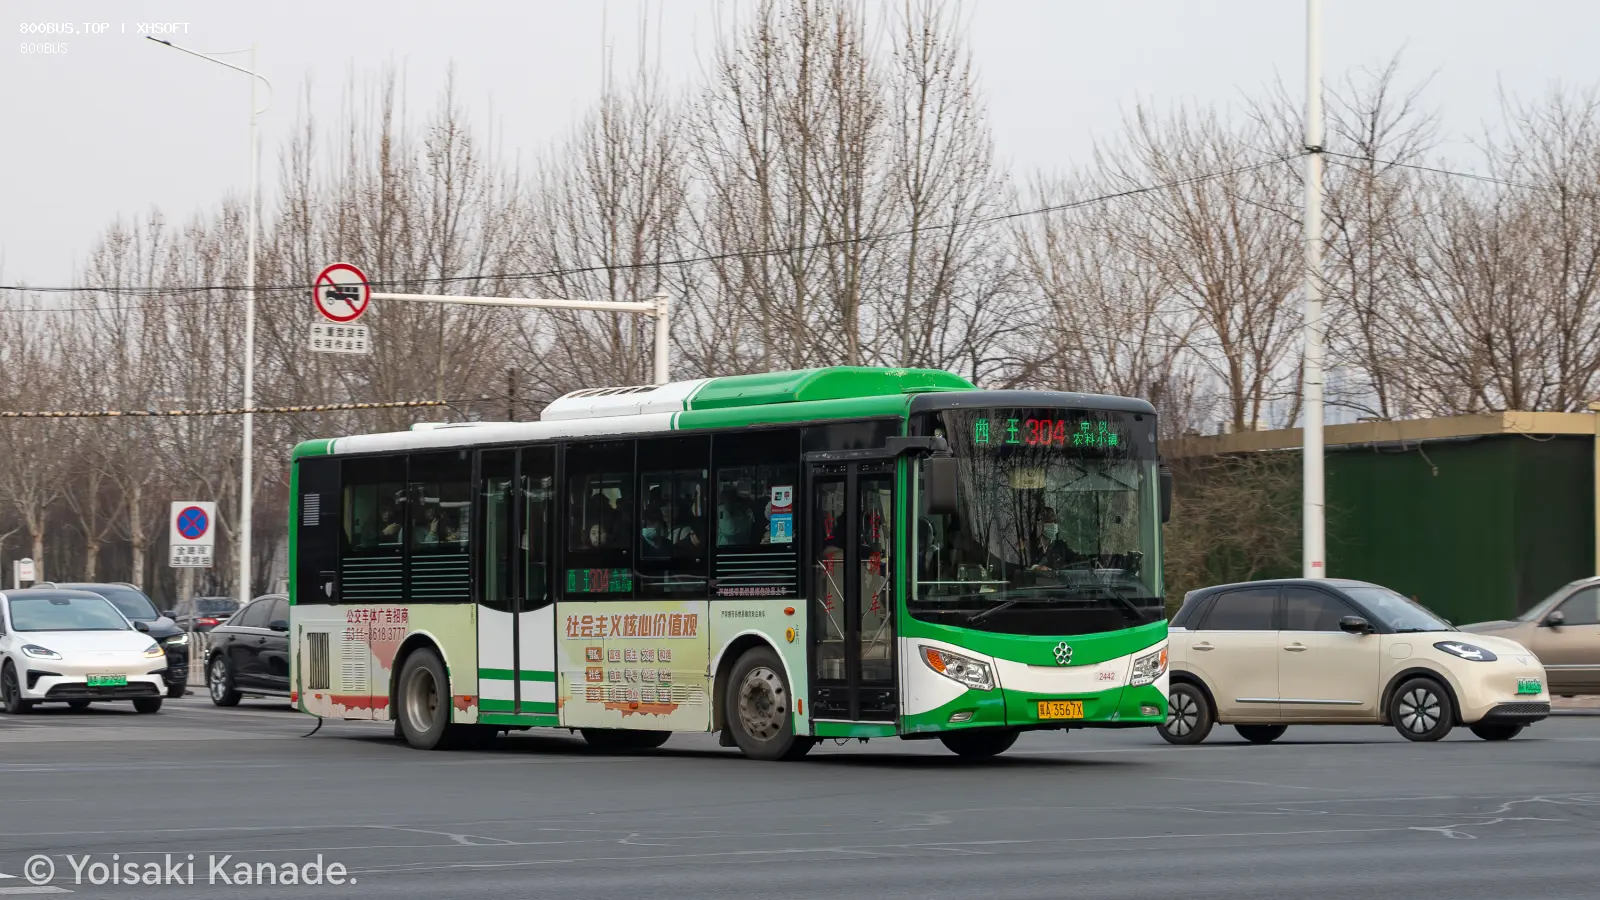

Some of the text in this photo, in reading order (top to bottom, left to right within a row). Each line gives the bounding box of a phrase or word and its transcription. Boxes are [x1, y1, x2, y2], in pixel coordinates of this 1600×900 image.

[1025, 418, 1065, 445] 304
[346, 607, 409, 624] 公交车体广告招商
[566, 613, 698, 638] 社会主义核心价值观
[1098, 672, 1115, 681] 2442
